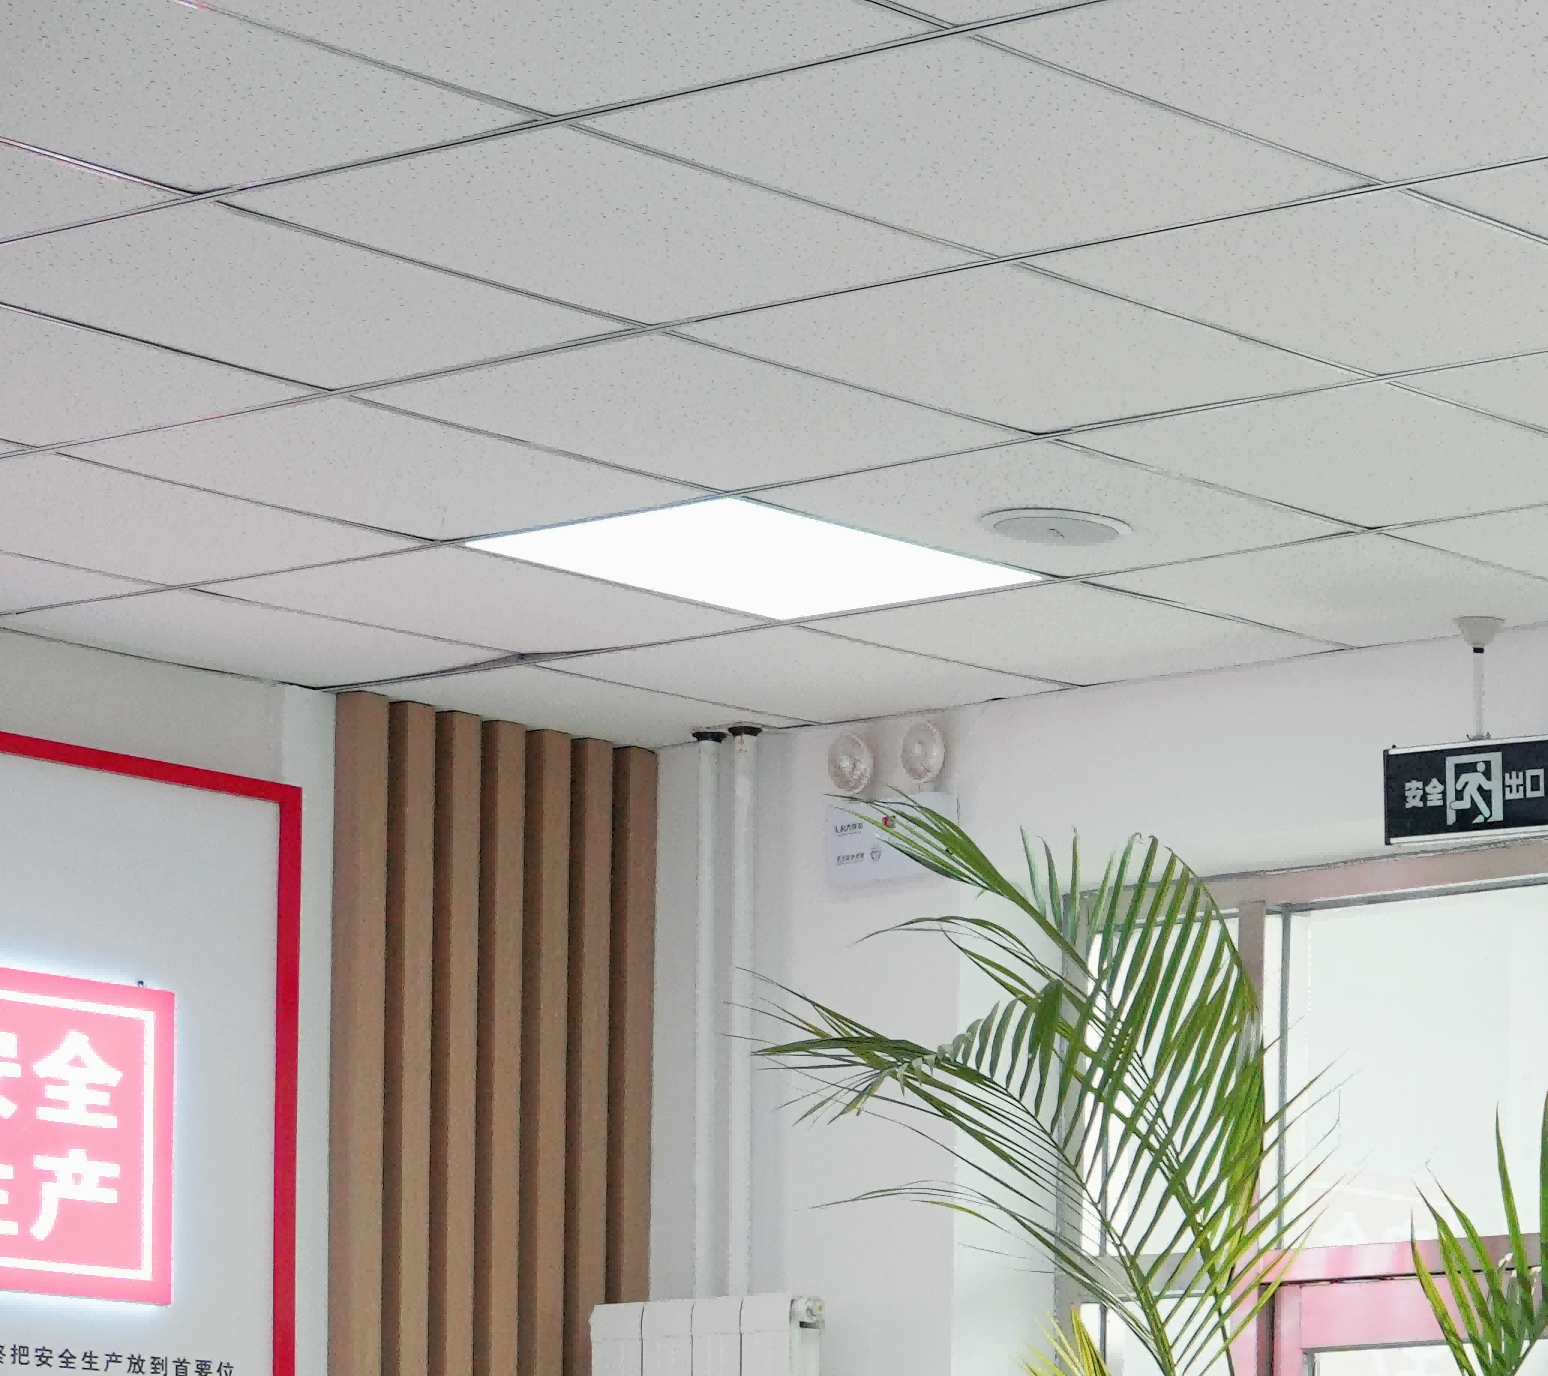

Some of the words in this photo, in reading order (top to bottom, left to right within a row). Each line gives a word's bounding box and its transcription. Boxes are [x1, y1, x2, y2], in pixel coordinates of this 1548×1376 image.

[1404, 777, 1445, 809] 安全
[1504, 768, 1545, 800] 出口
[0, 1028, 124, 1129] 全
[0, 1148, 121, 1241] 产
